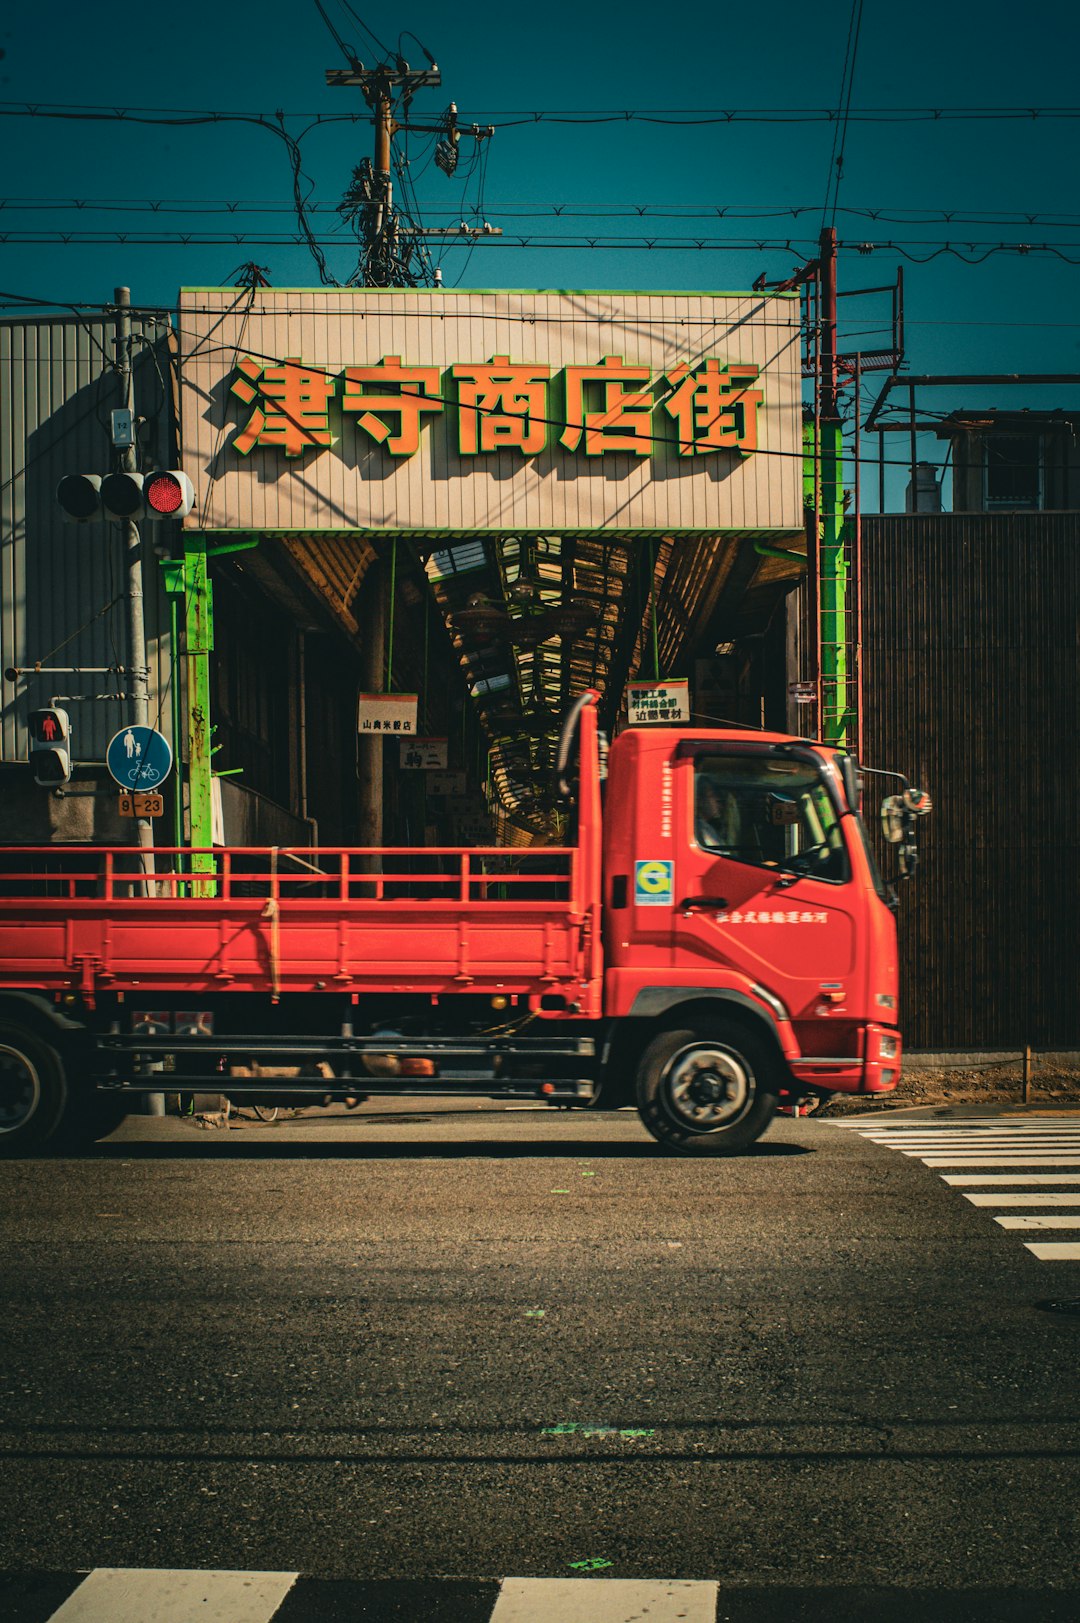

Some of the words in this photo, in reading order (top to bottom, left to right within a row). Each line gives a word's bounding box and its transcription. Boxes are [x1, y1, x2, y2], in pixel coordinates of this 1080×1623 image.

[231, 355, 764, 457] 津守商店街
